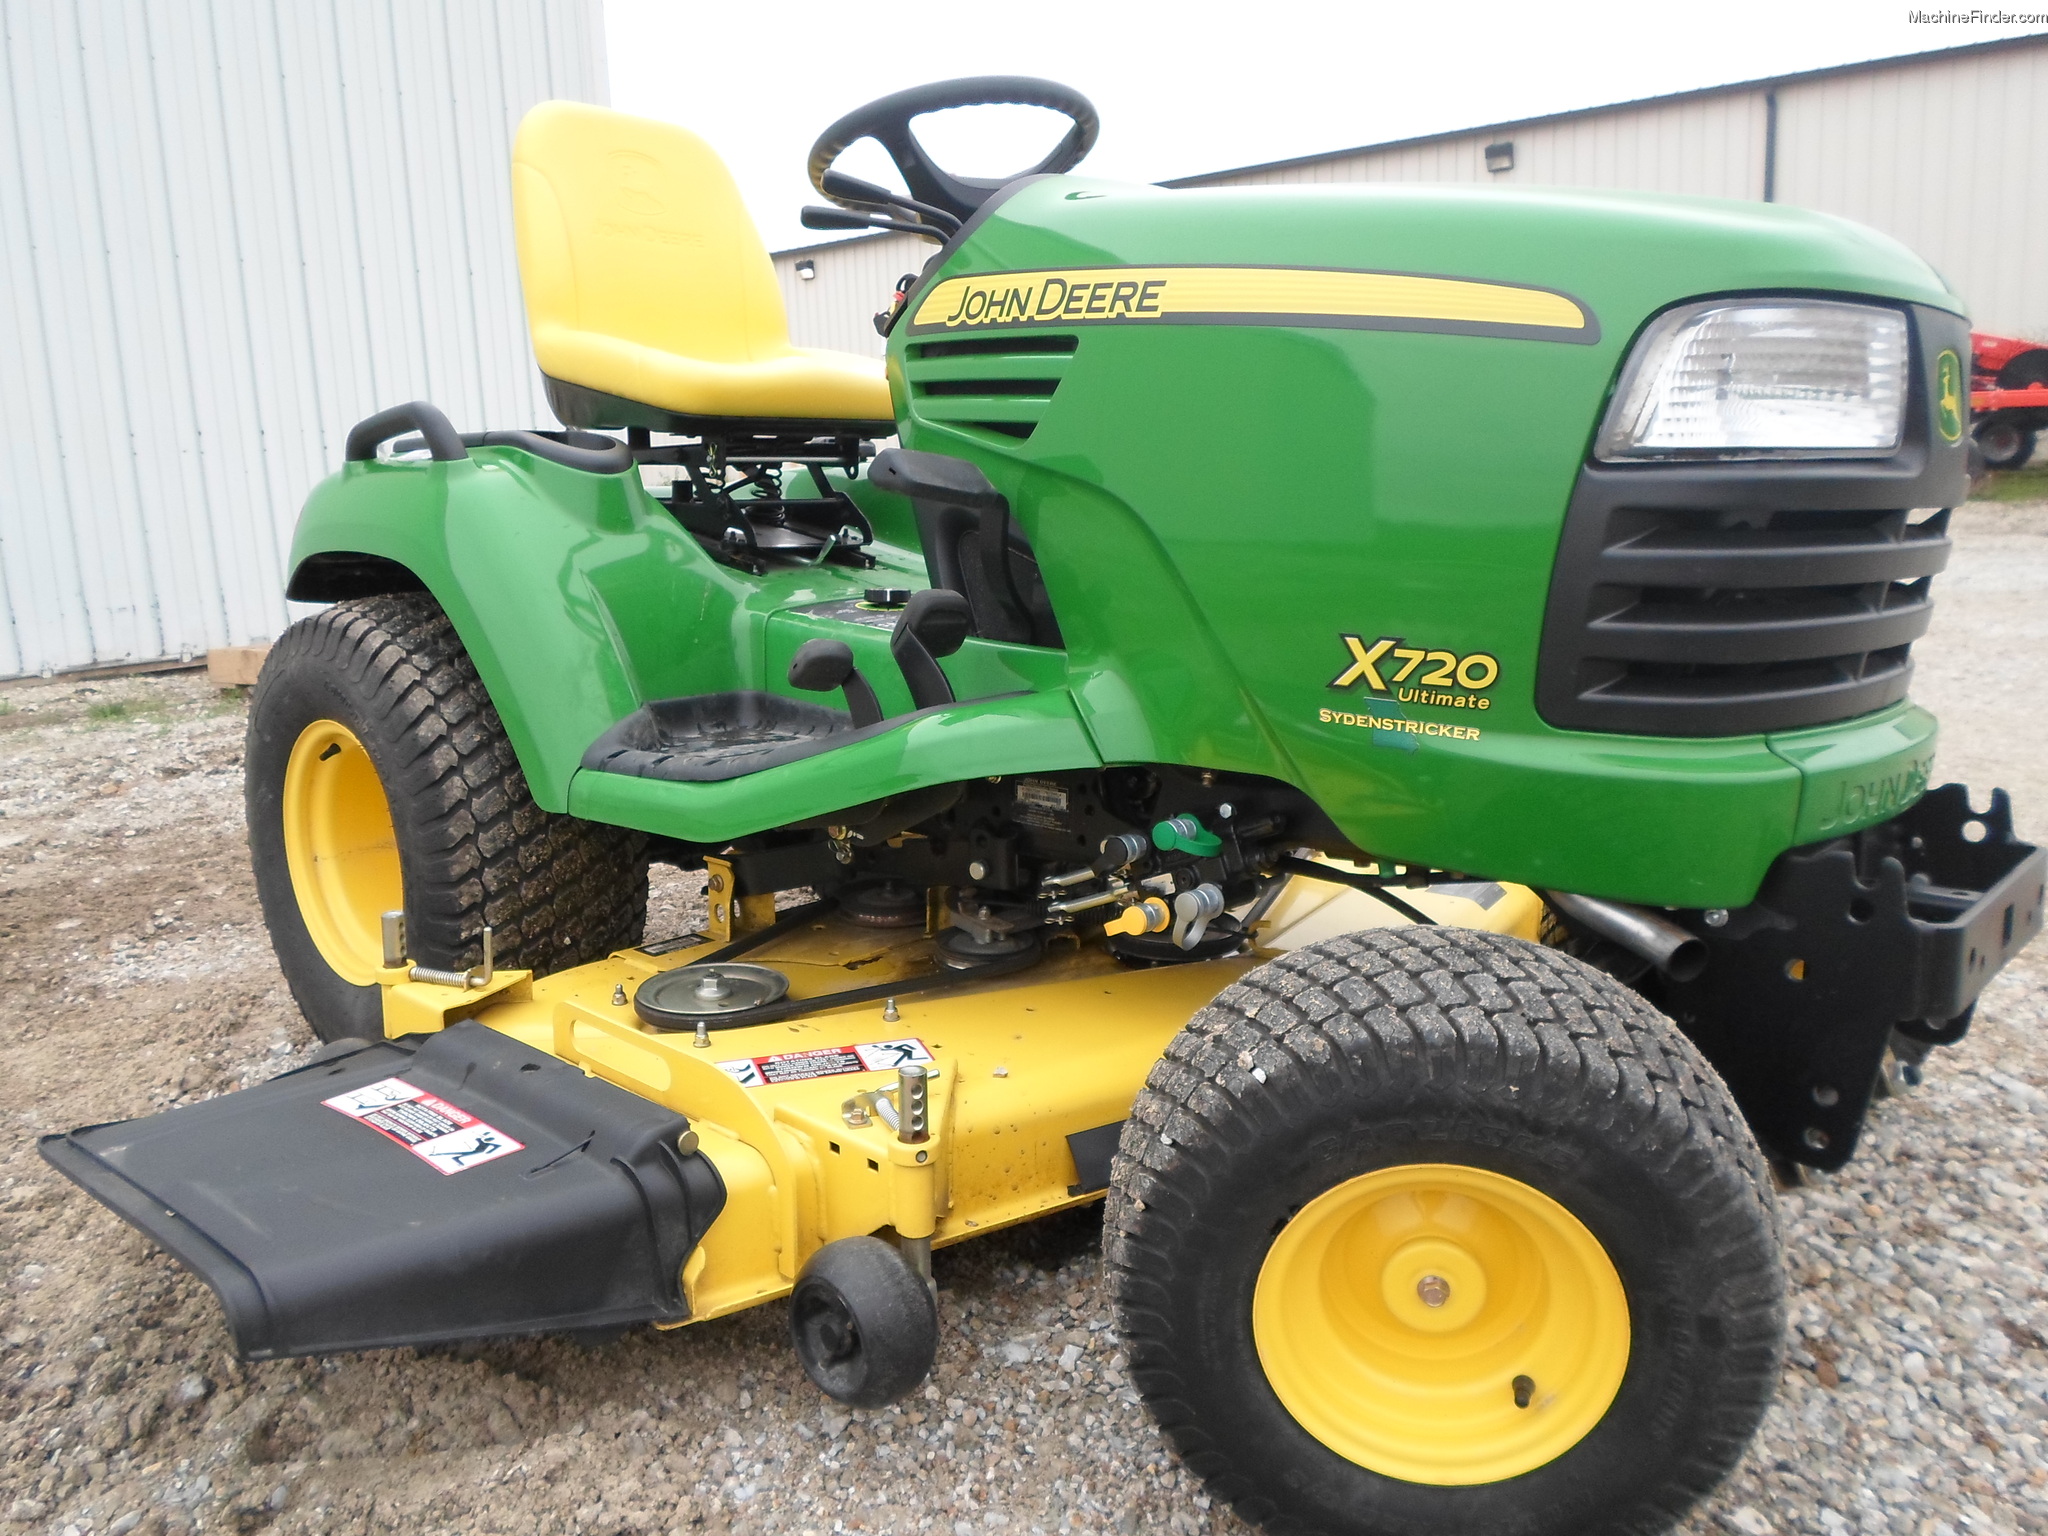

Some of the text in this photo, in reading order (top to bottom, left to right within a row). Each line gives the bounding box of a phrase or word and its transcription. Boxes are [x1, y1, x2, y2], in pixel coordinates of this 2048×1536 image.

[947, 277, 1167, 322] JOHN DEERE
[1328, 634, 1499, 693] X720
[1398, 687, 1491, 710] Ultimate
[1319, 708, 1481, 741] SYDENSTRICKER
[782, 1047, 842, 1061] DANGER
[431, 1102, 473, 1124] DANGER
